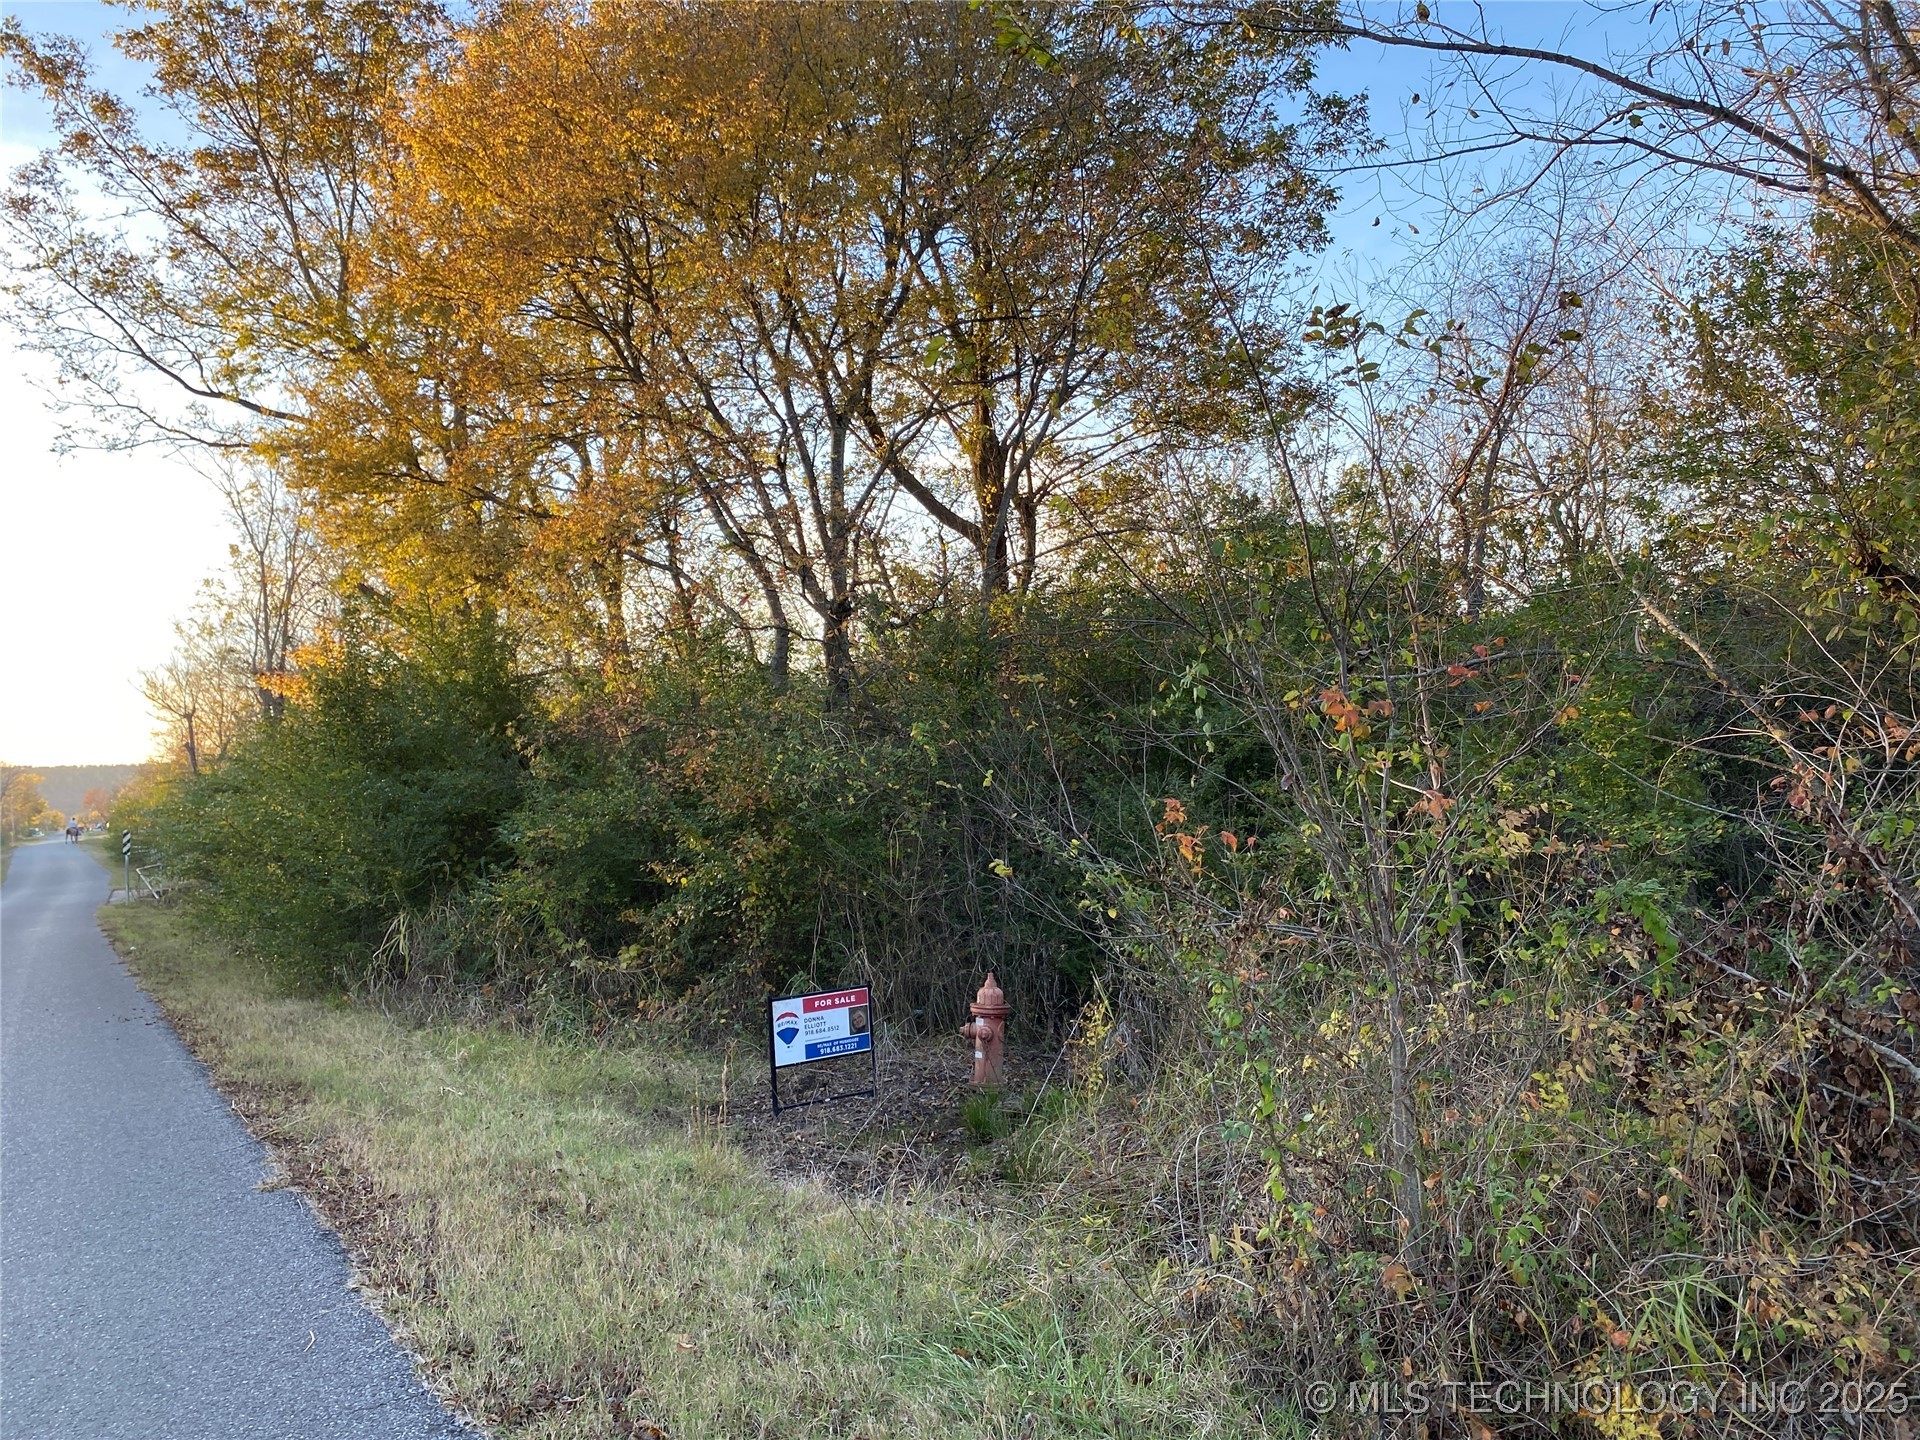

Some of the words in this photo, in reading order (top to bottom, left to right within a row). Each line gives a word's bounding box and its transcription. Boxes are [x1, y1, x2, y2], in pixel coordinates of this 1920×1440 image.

[814, 999, 832, 1008] FOR
[834, 995, 856, 1005] SALE
[777, 1020, 798, 1028] RE/MAX
[804, 1021, 826, 1029] ELLIOTT
